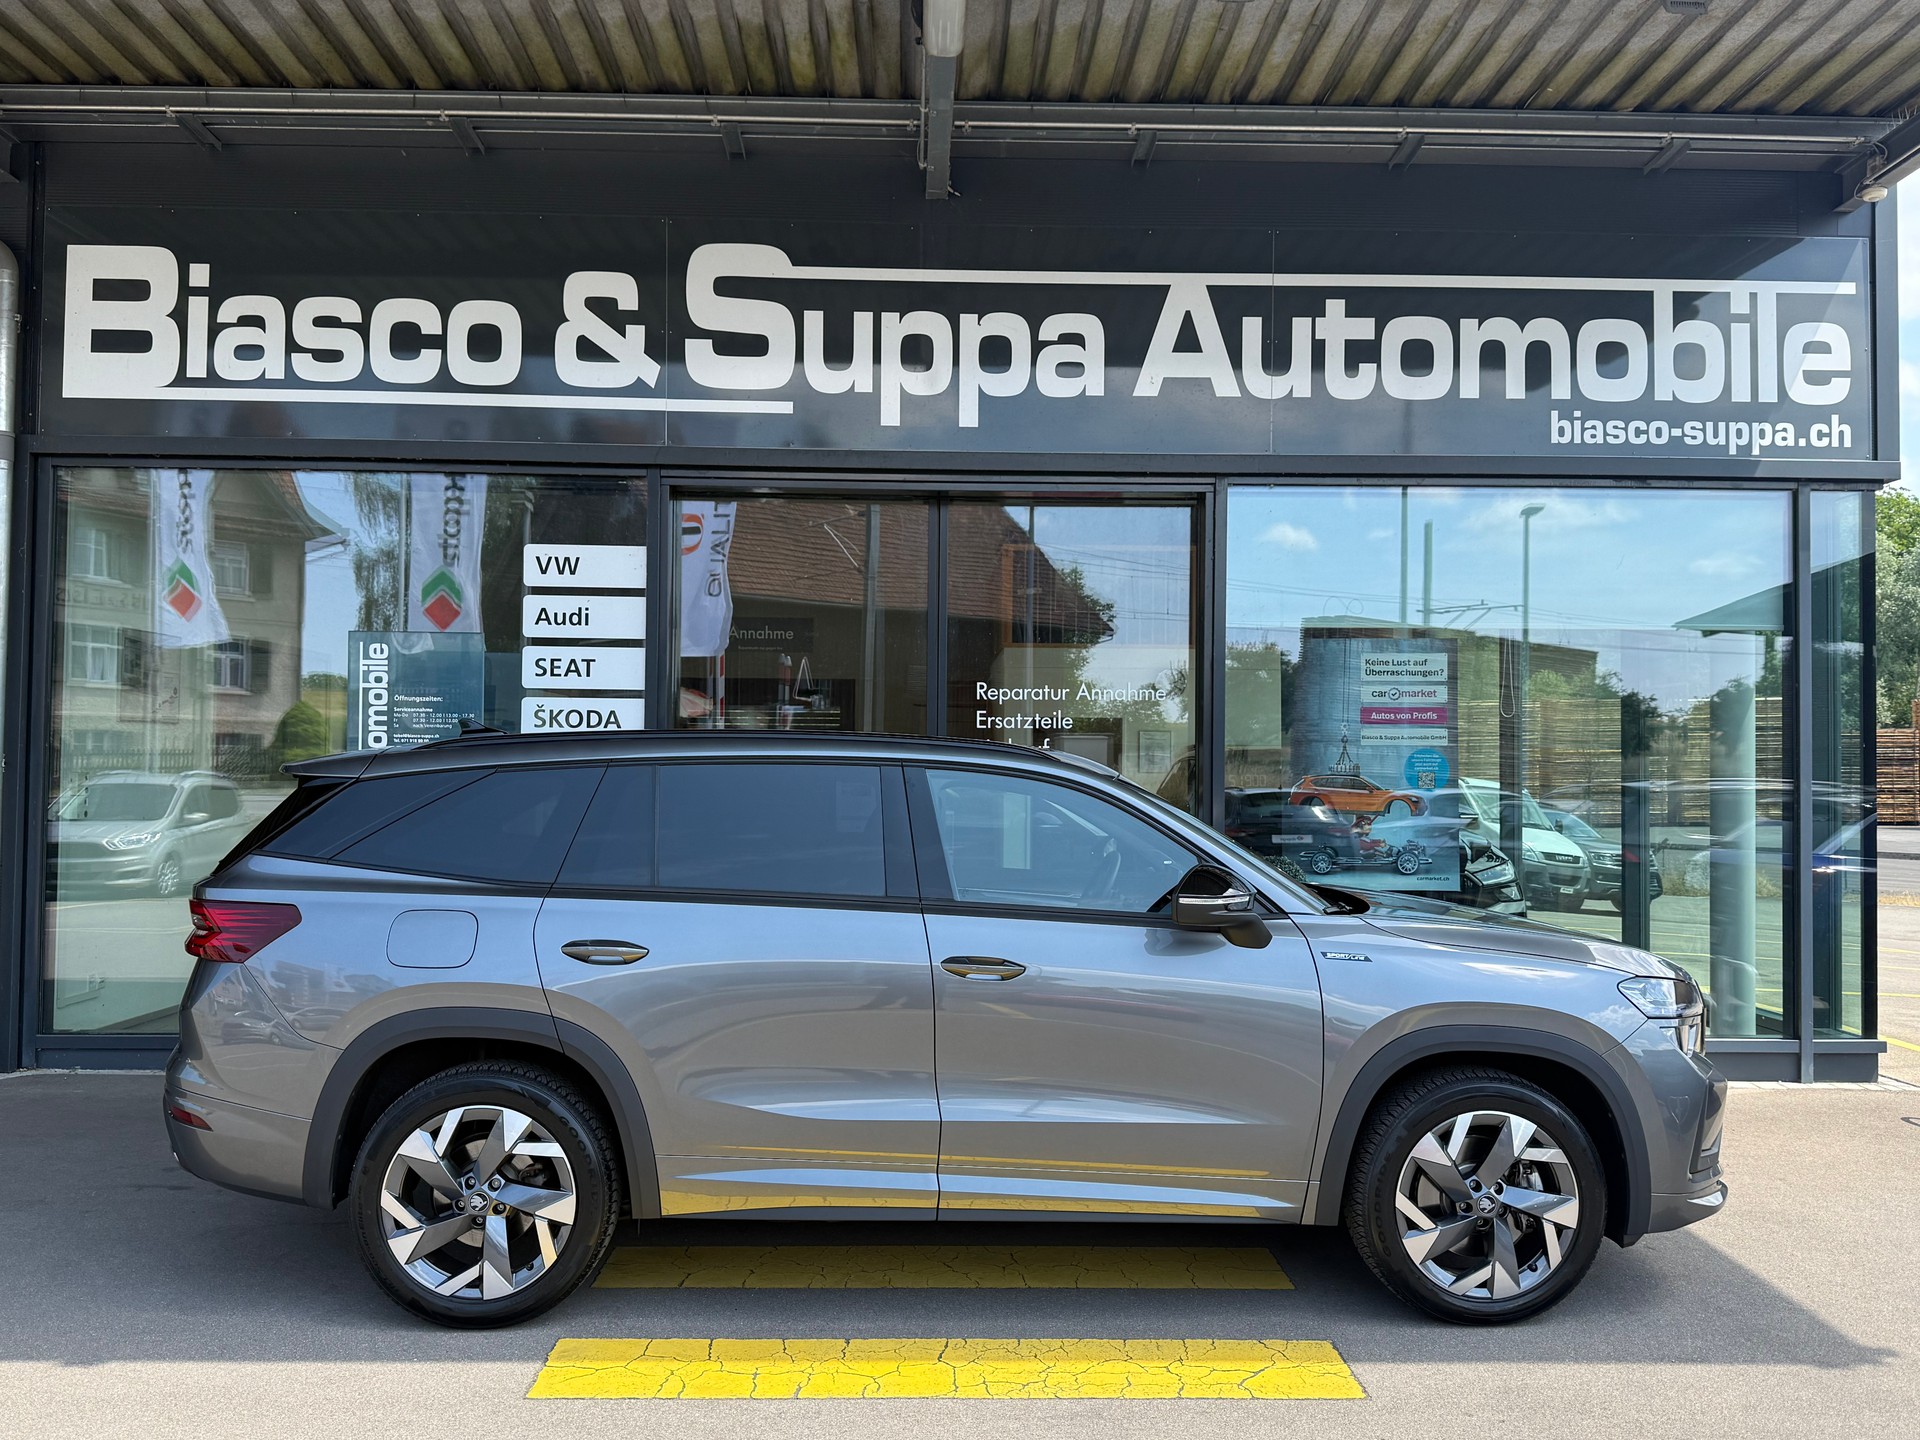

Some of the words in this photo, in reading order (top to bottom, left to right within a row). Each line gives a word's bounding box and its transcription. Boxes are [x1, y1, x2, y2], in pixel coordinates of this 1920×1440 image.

[62, 244, 523, 398] Biasco
[554, 271, 661, 389] &
[685, 243, 1105, 427] Suppa
[1132, 272, 1853, 406] Automobile
[1551, 410, 1852, 456] biasco-suppa.ch
[535, 556, 580, 576] VW
[534, 607, 590, 626] Audi
[729, 625, 794, 640] Annahme
[534, 658, 596, 678] SEAT
[1365, 658, 1390, 667] Keine
[1391, 658, 1411, 667] Lust
[1412, 658, 1428, 667] auf
[1365, 667, 1444, 678] Überraschungen?
[976, 681, 1070, 704] Reparatur
[1076, 681, 1166, 701] Annahme
[533, 704, 622, 729] ŠKODA
[976, 710, 1073, 730] Ersatzteile
[1371, 712, 1395, 720] Autos
[1412, 711, 1438, 720] Profis
